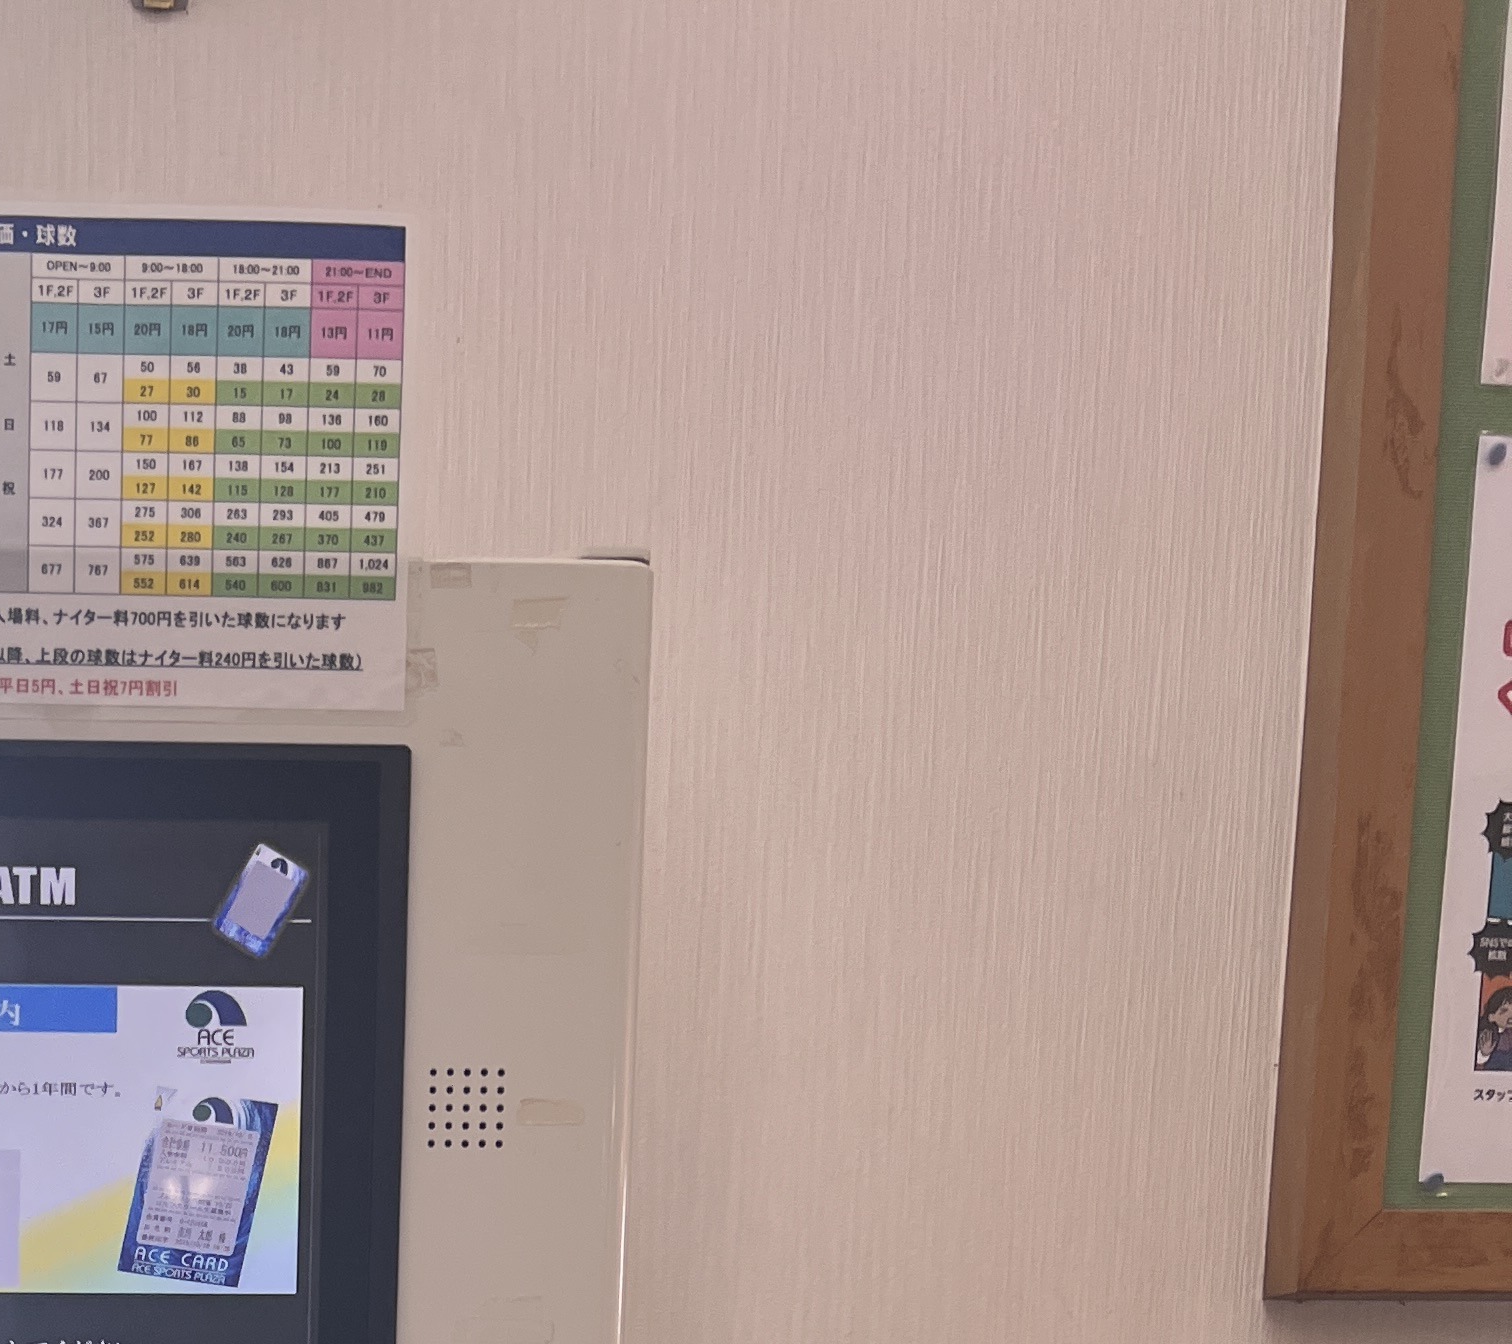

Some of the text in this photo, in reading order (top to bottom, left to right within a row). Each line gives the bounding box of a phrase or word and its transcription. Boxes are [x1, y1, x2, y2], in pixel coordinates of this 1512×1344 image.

[93, 286, 110, 299] 3F
[187, 288, 204, 301] 3F
[280, 290, 297, 302] 3F
[373, 292, 390, 304] 3F
[41, 320, 67, 335] 17円
[88, 322, 114, 336] 15円
[134, 323, 161, 337] 20円
[181, 324, 208, 338] 18円
[227, 324, 254, 339] 20円
[274, 325, 301, 339] 18円
[321, 326, 347, 340] 13円
[368, 327, 393, 341] 11円
[3, 354, 16, 367] 土
[47, 370, 61, 382] 59
[4, 418, 15, 431] 日
[44, 420, 64, 432] 118
[43, 468, 63, 480] 177
[366, 463, 386, 475] 251
[2, 482, 15, 495] 祝
[364, 511, 385, 523] 479
[359, 559, 389, 572] 1,024
[198, 1029, 234, 1046] ACE
[134, 1247, 228, 1271] ACE CARD
